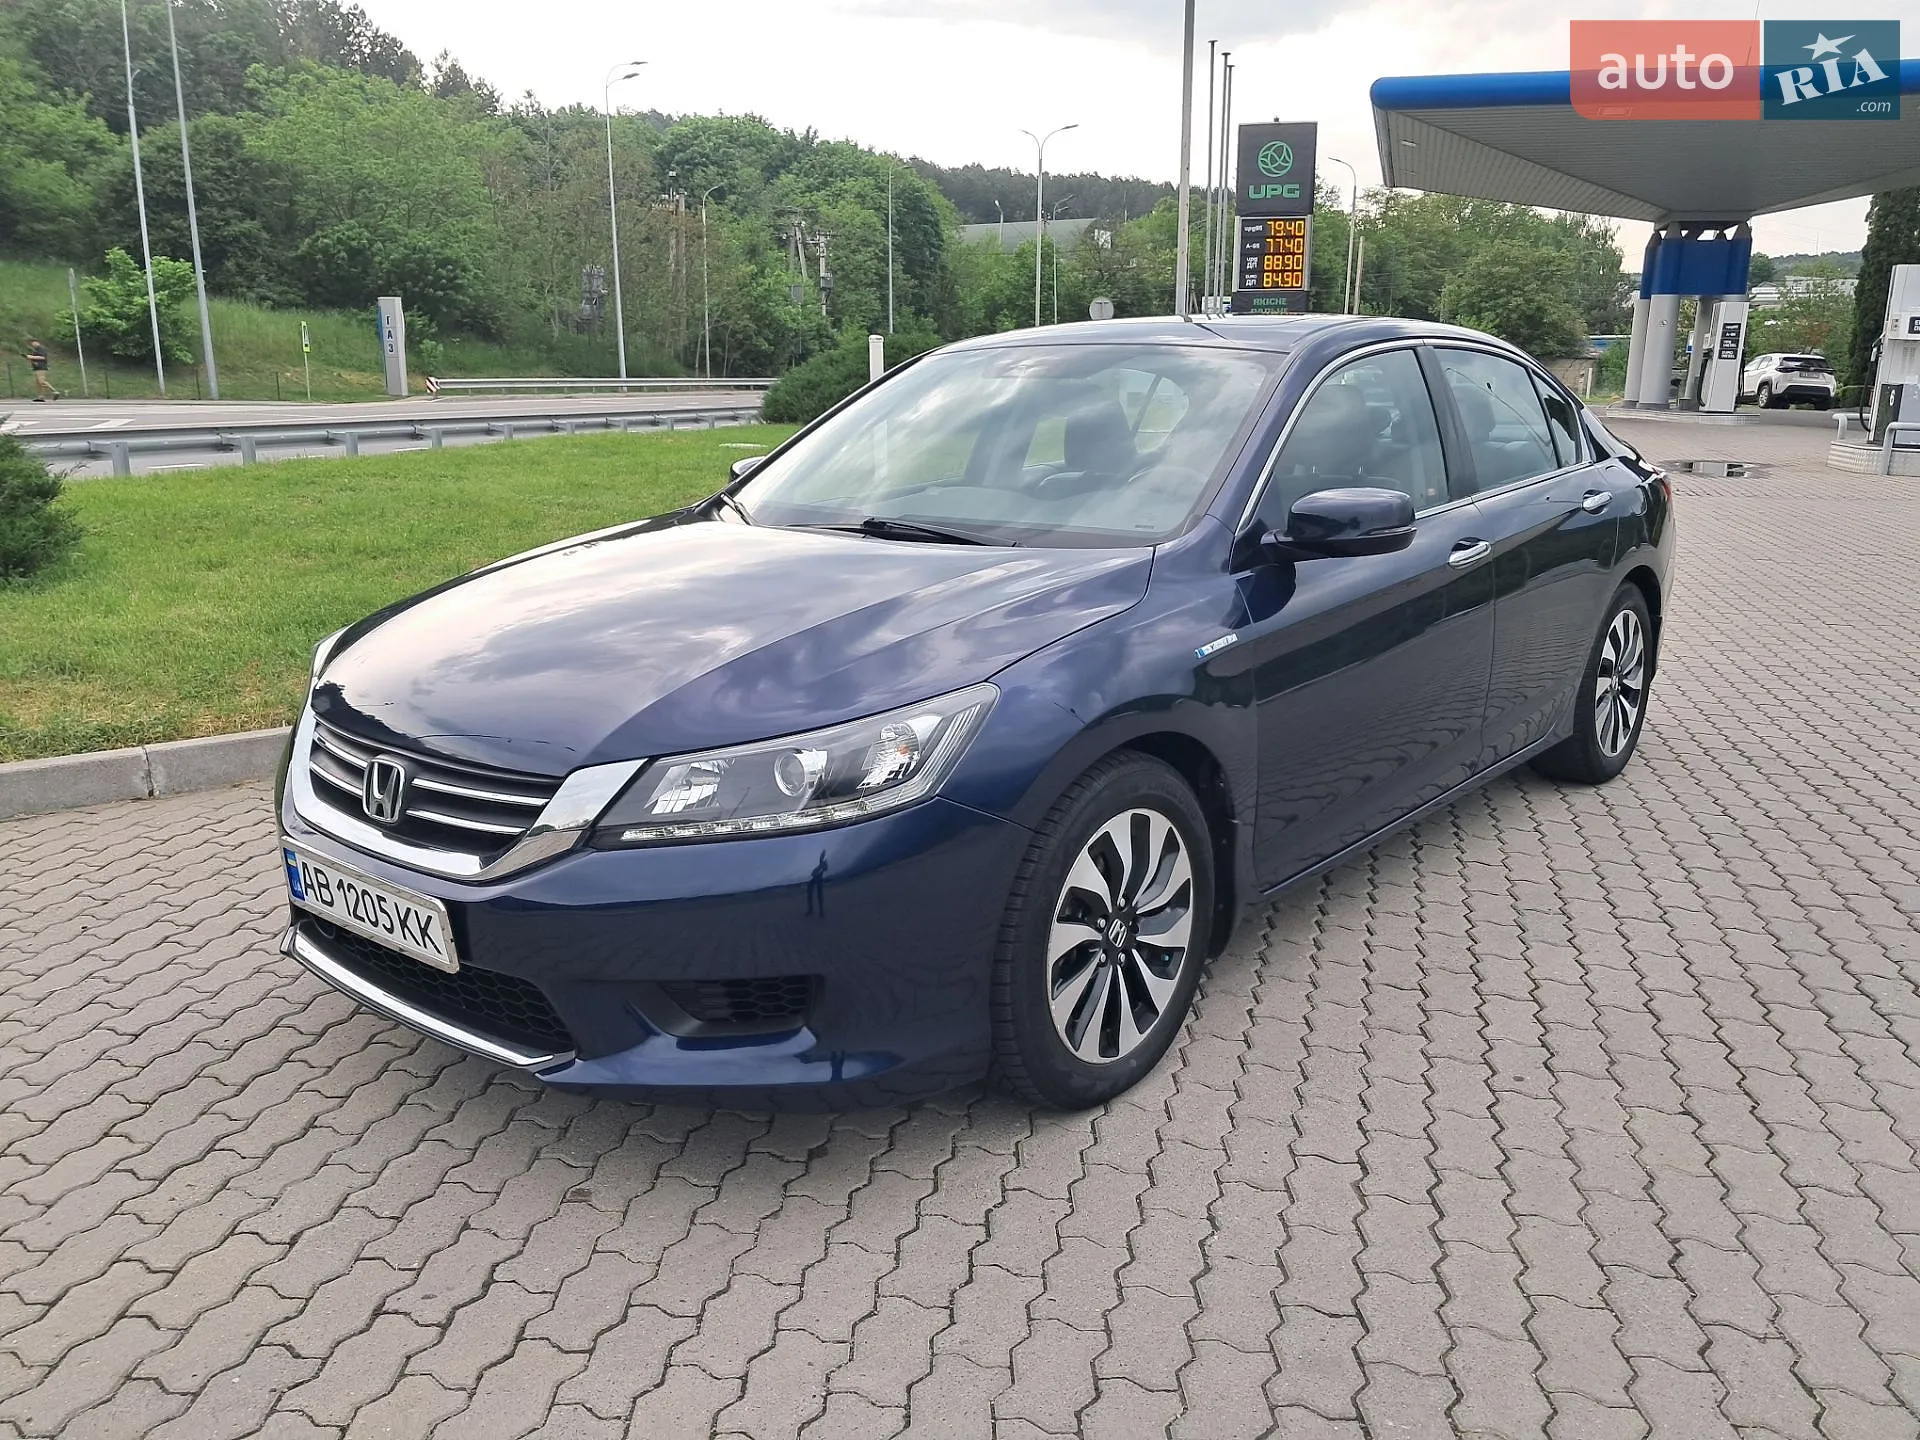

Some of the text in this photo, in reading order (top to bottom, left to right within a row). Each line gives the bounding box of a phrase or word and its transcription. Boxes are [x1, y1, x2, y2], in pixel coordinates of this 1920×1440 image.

[1248, 183, 1300, 199] UPG
[1266, 220, 1305, 237] 79.40
[1265, 238, 1304, 253] 77.40
[1263, 254, 1303, 270] 88.90
[1262, 271, 1302, 288] 84.90
[1889, 389, 1896, 406] 6
[301, 861, 442, 955] AB 1205 KK
